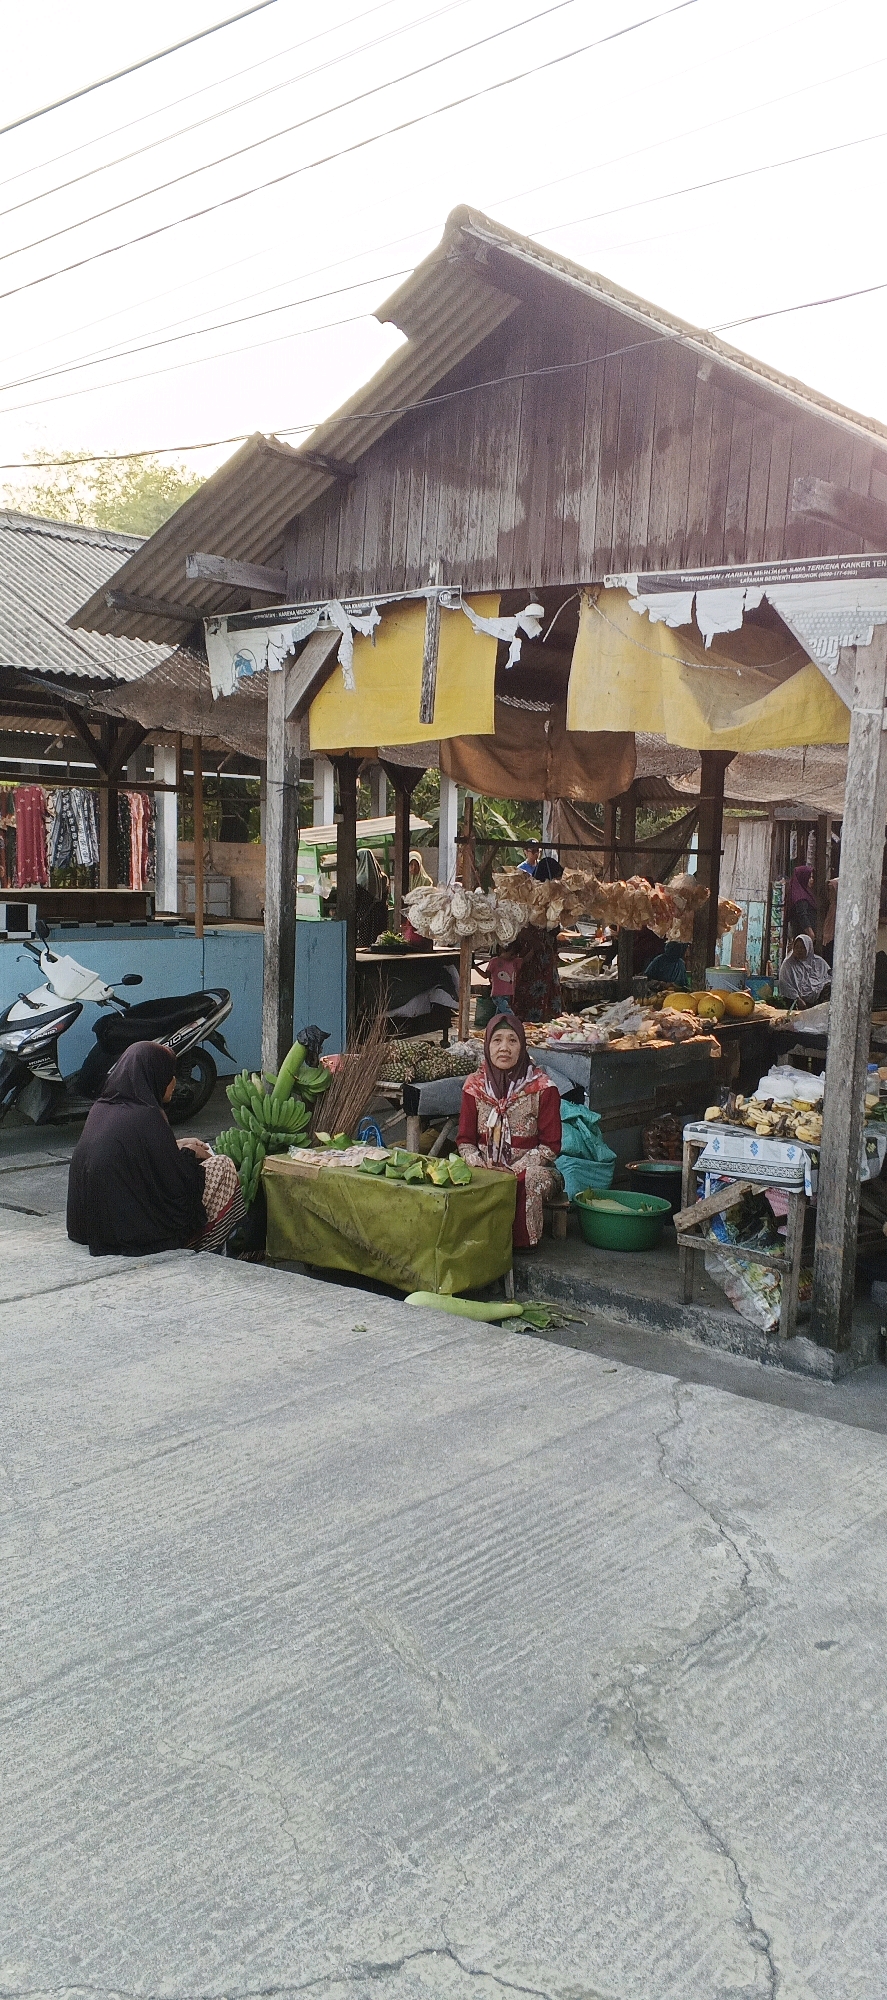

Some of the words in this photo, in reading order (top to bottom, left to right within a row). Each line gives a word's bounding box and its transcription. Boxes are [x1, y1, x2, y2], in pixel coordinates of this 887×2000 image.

[807, 562, 840, 571] TERKENA
[841, 560, 871, 569] KANKER
[873, 559, 887, 567] TEN
[28, 1056, 51, 1066] HONDA
